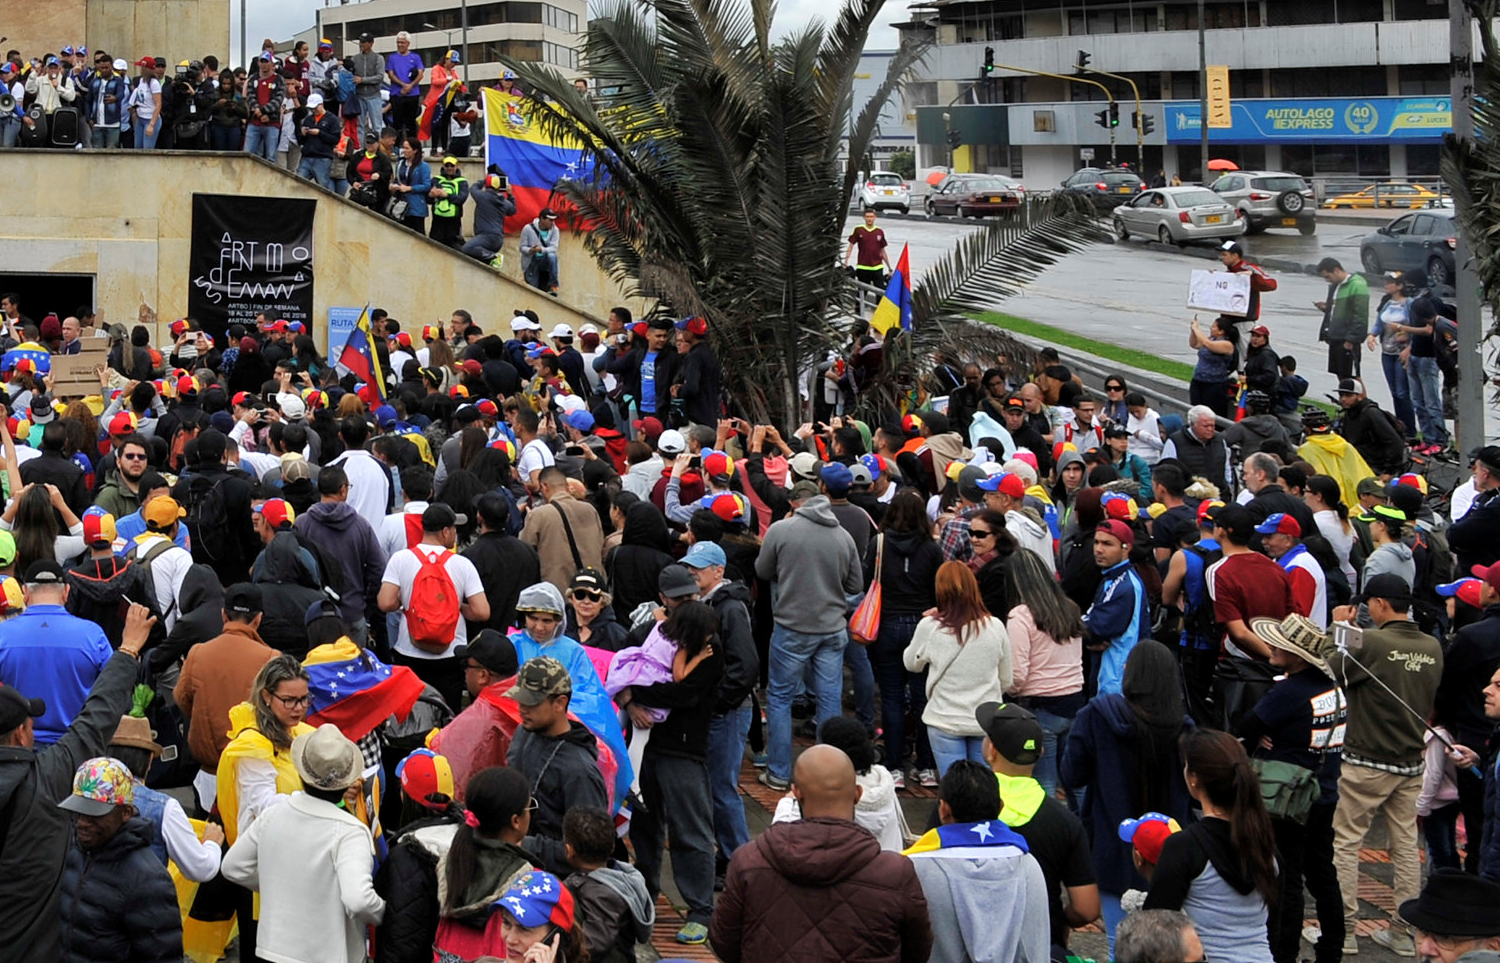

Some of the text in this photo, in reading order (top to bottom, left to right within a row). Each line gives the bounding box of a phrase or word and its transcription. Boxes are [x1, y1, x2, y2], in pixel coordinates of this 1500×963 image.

[1265, 108, 1335, 119] AUTOLAGO
[1352, 107, 1370, 118] 40
[1281, 118, 1334, 129] EXPRESS
[331, 319, 353, 327] RUTA
